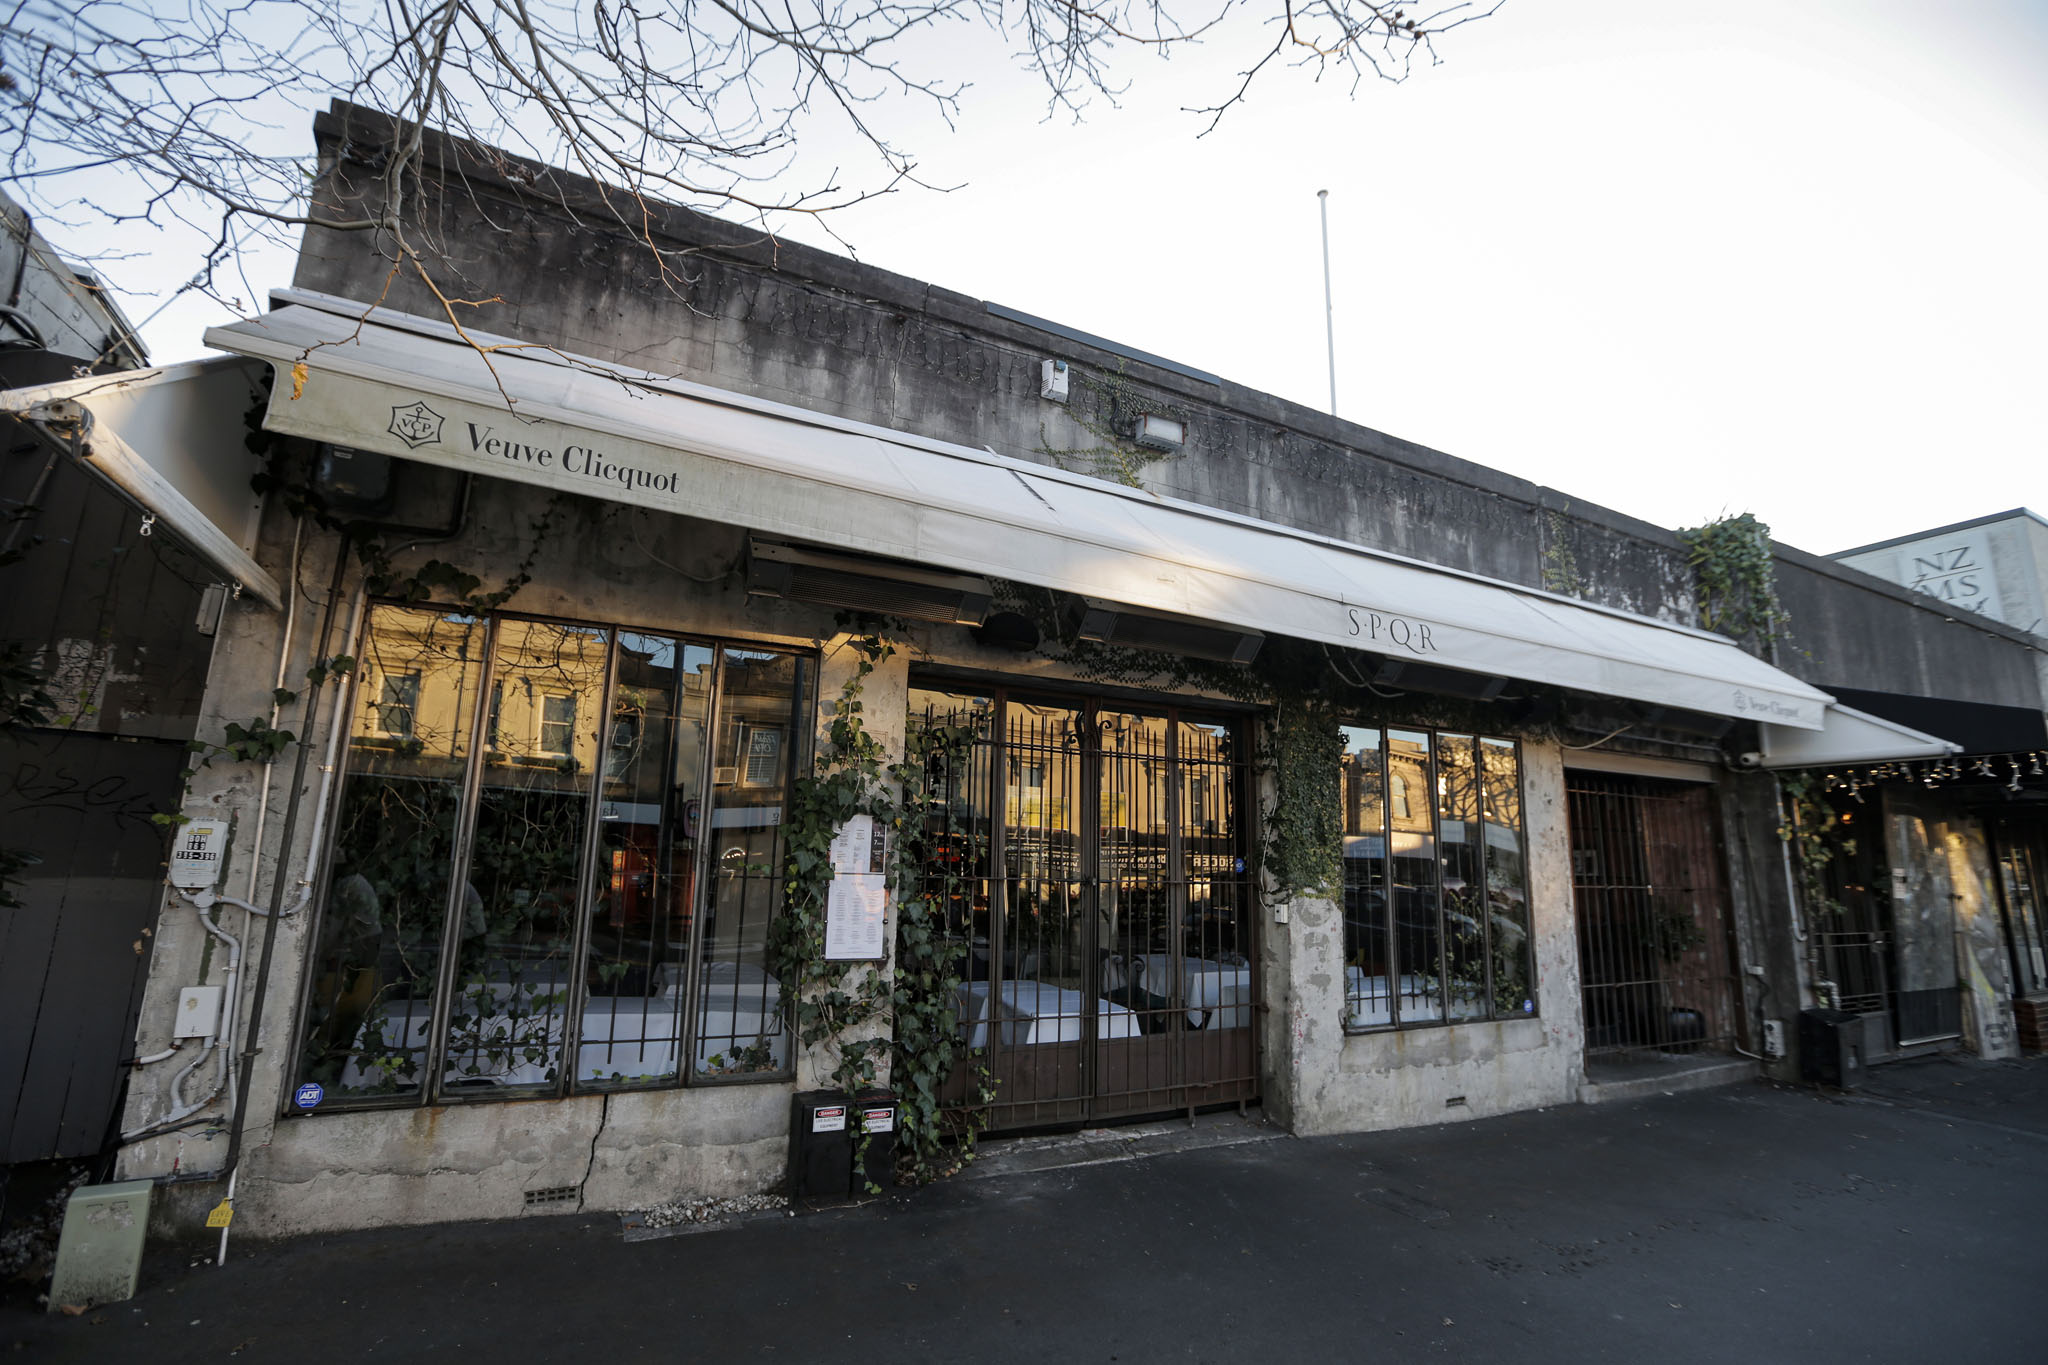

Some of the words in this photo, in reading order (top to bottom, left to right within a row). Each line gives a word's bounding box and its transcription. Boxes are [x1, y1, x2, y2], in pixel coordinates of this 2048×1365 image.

[465, 421, 552, 467] Veuve
[562, 446, 679, 493] Clicquot
[1912, 546, 1976, 577] NZ
[300, 1091, 319, 1099] ADT
